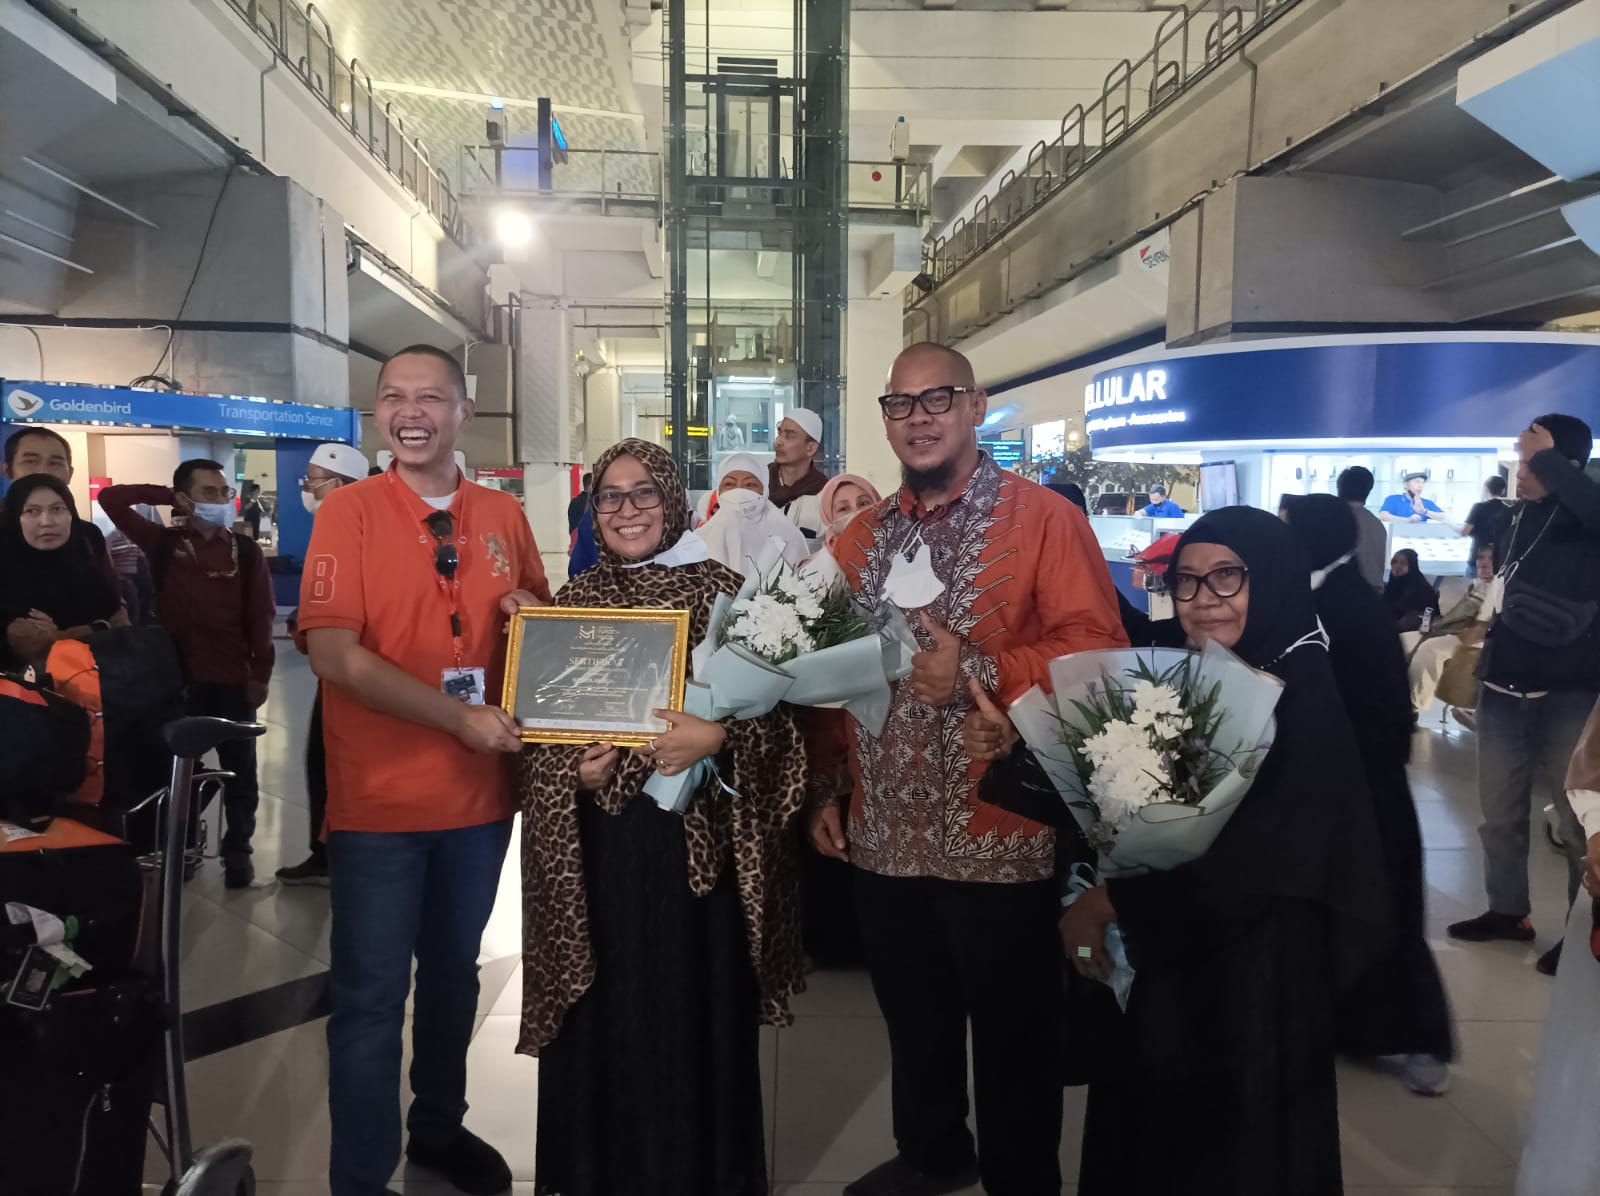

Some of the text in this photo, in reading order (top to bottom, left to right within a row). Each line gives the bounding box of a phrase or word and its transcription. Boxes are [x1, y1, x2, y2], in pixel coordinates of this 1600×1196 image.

[50, 398, 132, 415] Goldenbird
[219, 403, 334, 426] Transportation Service
